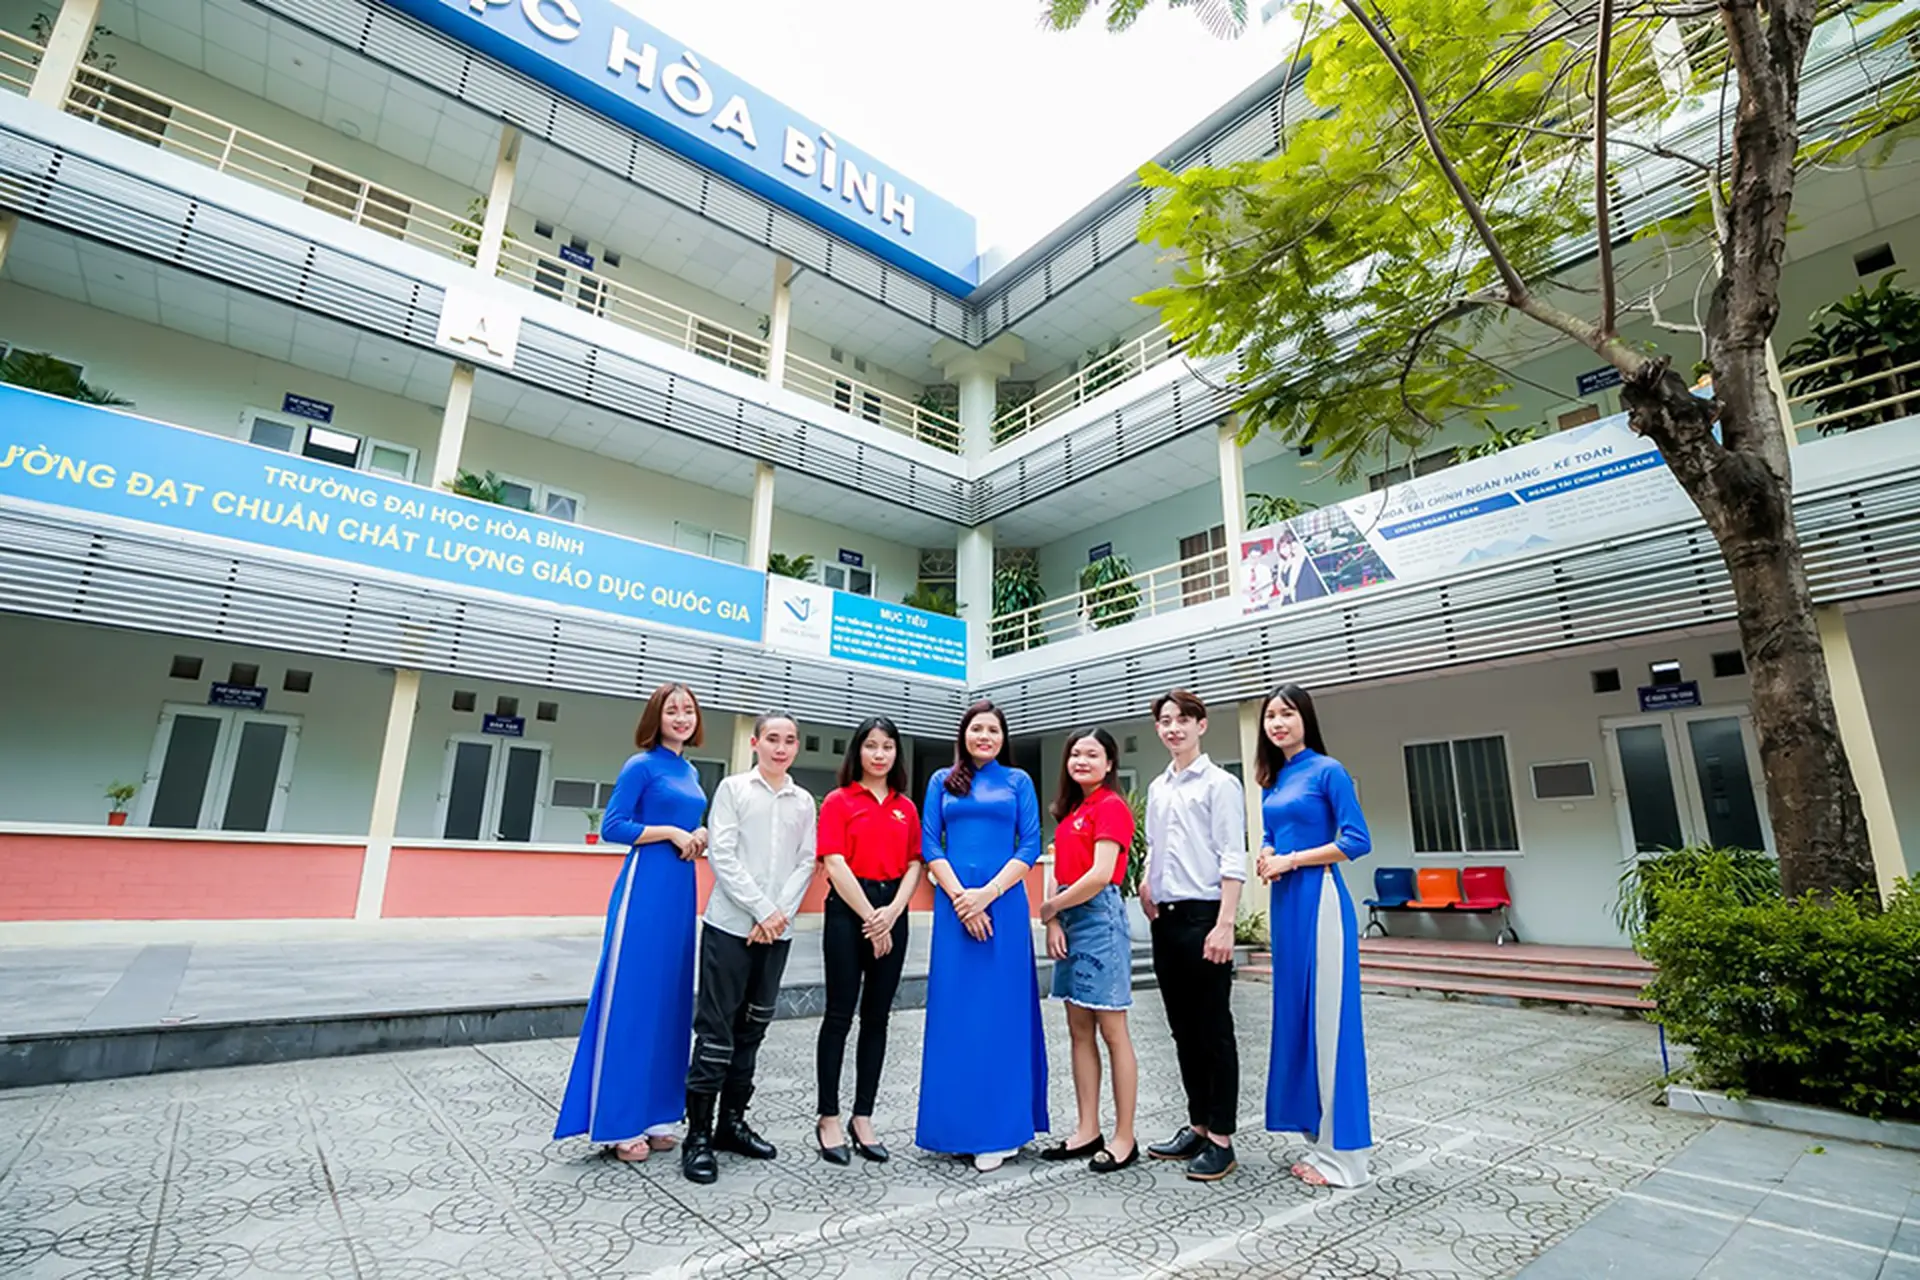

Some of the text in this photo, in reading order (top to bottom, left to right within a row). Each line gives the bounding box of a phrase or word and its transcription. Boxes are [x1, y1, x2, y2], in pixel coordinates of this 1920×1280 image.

[606, 26, 757, 149] HÒA
[782, 125, 915, 234] BÌNH
[127, 471, 204, 508] ĐẠT
[212, 490, 329, 535] CHUẨN
[337, 515, 420, 553] CHẤT
[426, 536, 524, 576] LƯỢNG
[532, 559, 592, 590] GIÁO
[598, 574, 645, 602] DỤC
[651, 586, 711, 615] QUỐC
[716, 601, 750, 623] GIA
[264, 465, 585, 556] TRƯỜNG ĐẠI HỌC HÒA BÌNH
